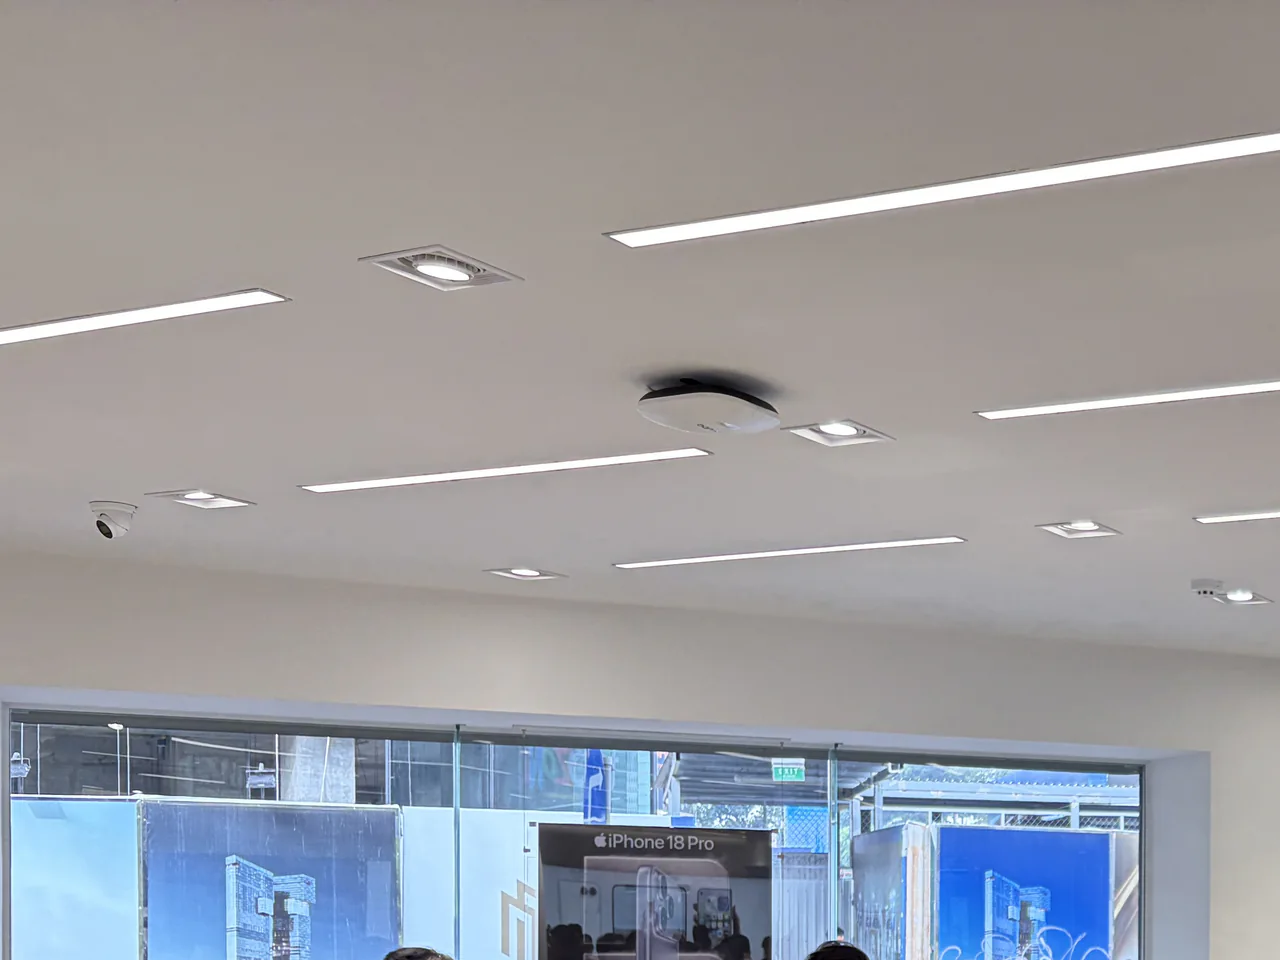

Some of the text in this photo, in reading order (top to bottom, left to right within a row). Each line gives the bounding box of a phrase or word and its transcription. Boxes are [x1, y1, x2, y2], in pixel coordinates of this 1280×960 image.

[608, 833, 715, 851] iPhone 18 Pro
